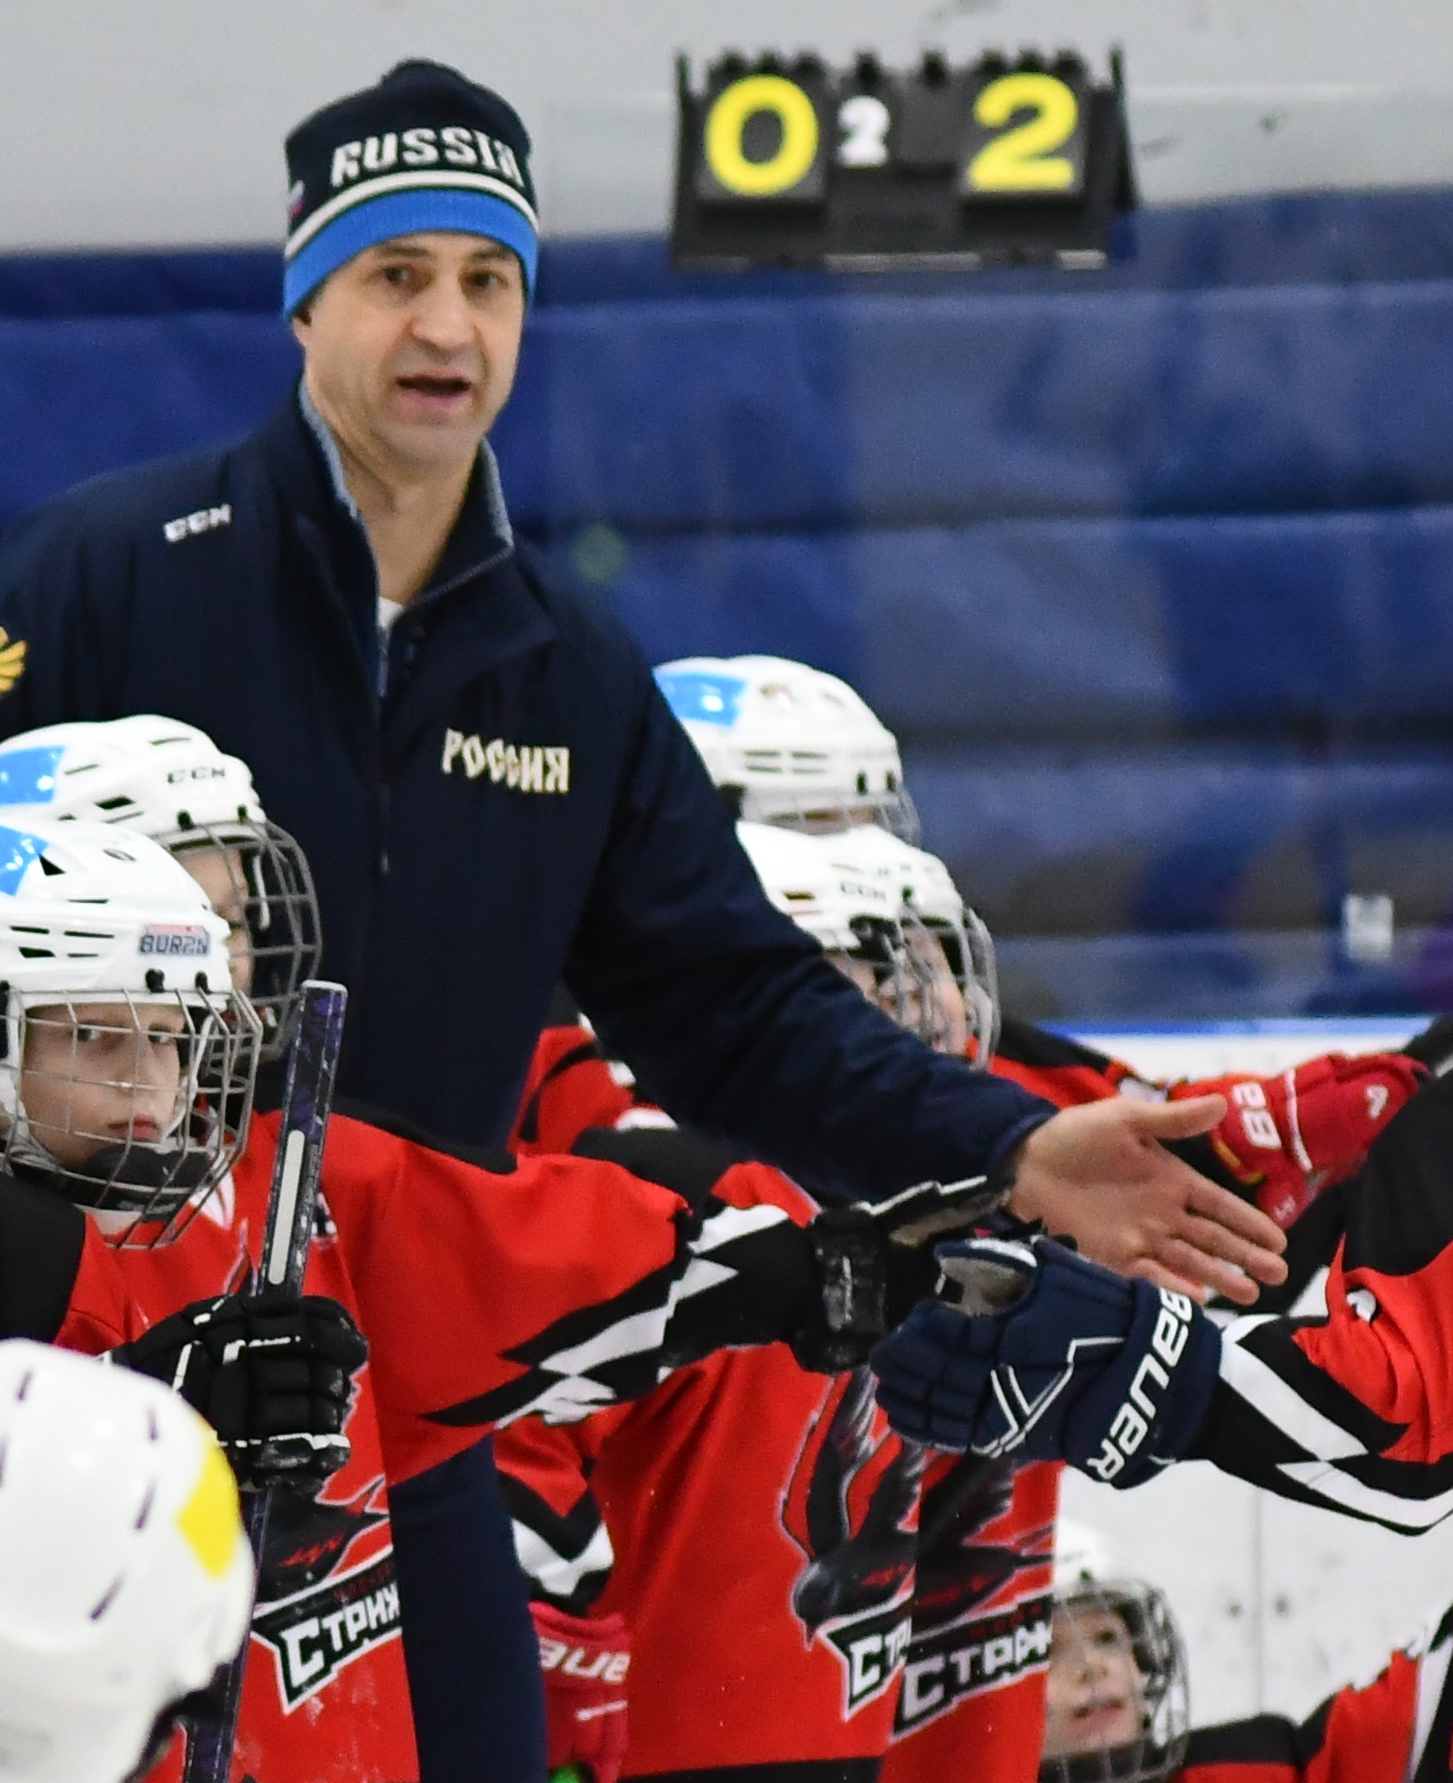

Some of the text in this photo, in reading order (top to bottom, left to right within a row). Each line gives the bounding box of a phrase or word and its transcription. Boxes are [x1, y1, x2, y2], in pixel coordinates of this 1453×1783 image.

[330, 126, 524, 188] RUSSIA
[705, 72, 1078, 196] 0 2 2
